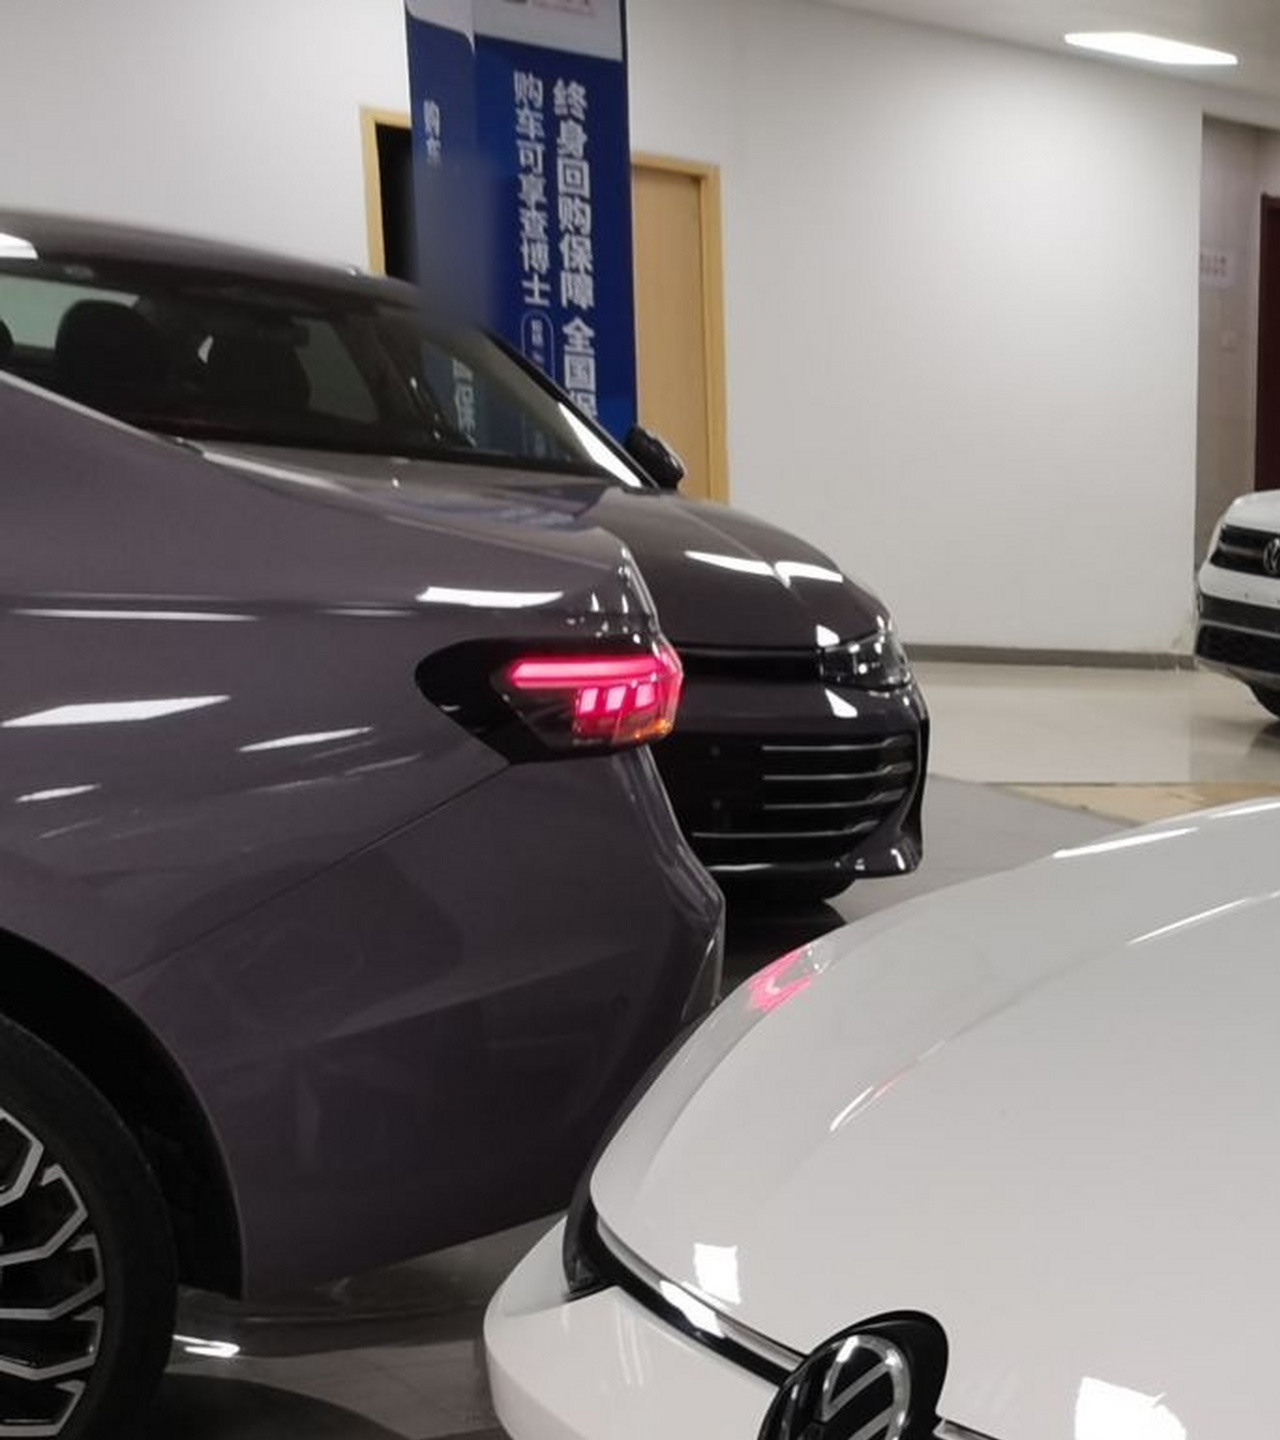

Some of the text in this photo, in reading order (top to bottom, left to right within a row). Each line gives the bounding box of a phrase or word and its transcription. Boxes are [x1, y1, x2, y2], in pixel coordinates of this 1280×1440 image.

[513, 69, 551, 307] 购车可享查博士
[552, 78, 595, 311] 终身回购保障
